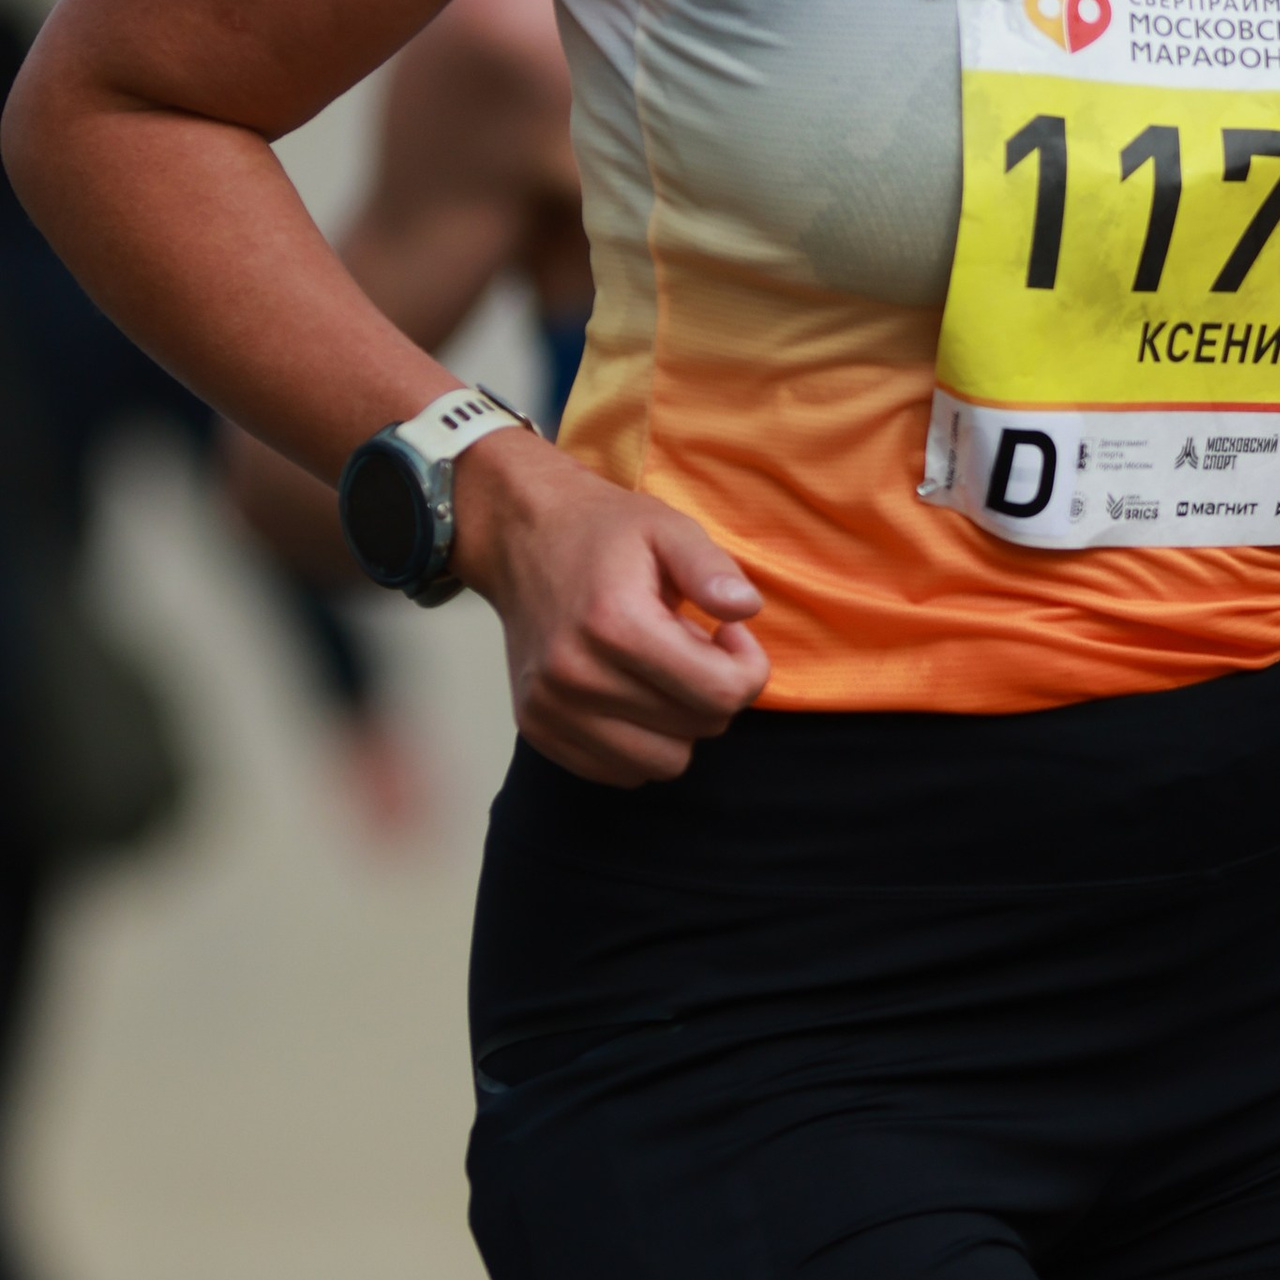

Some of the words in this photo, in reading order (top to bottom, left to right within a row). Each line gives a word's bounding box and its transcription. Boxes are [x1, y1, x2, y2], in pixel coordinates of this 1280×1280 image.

[1205, 434, 1279, 453] МОСКОВСКИЙ
[1203, 454, 1237, 470] СПОРТ
[985, 427, 1057, 518] D
[1124, 507, 1158, 520] BRICS
[1191, 501, 1258, 515] магнит
